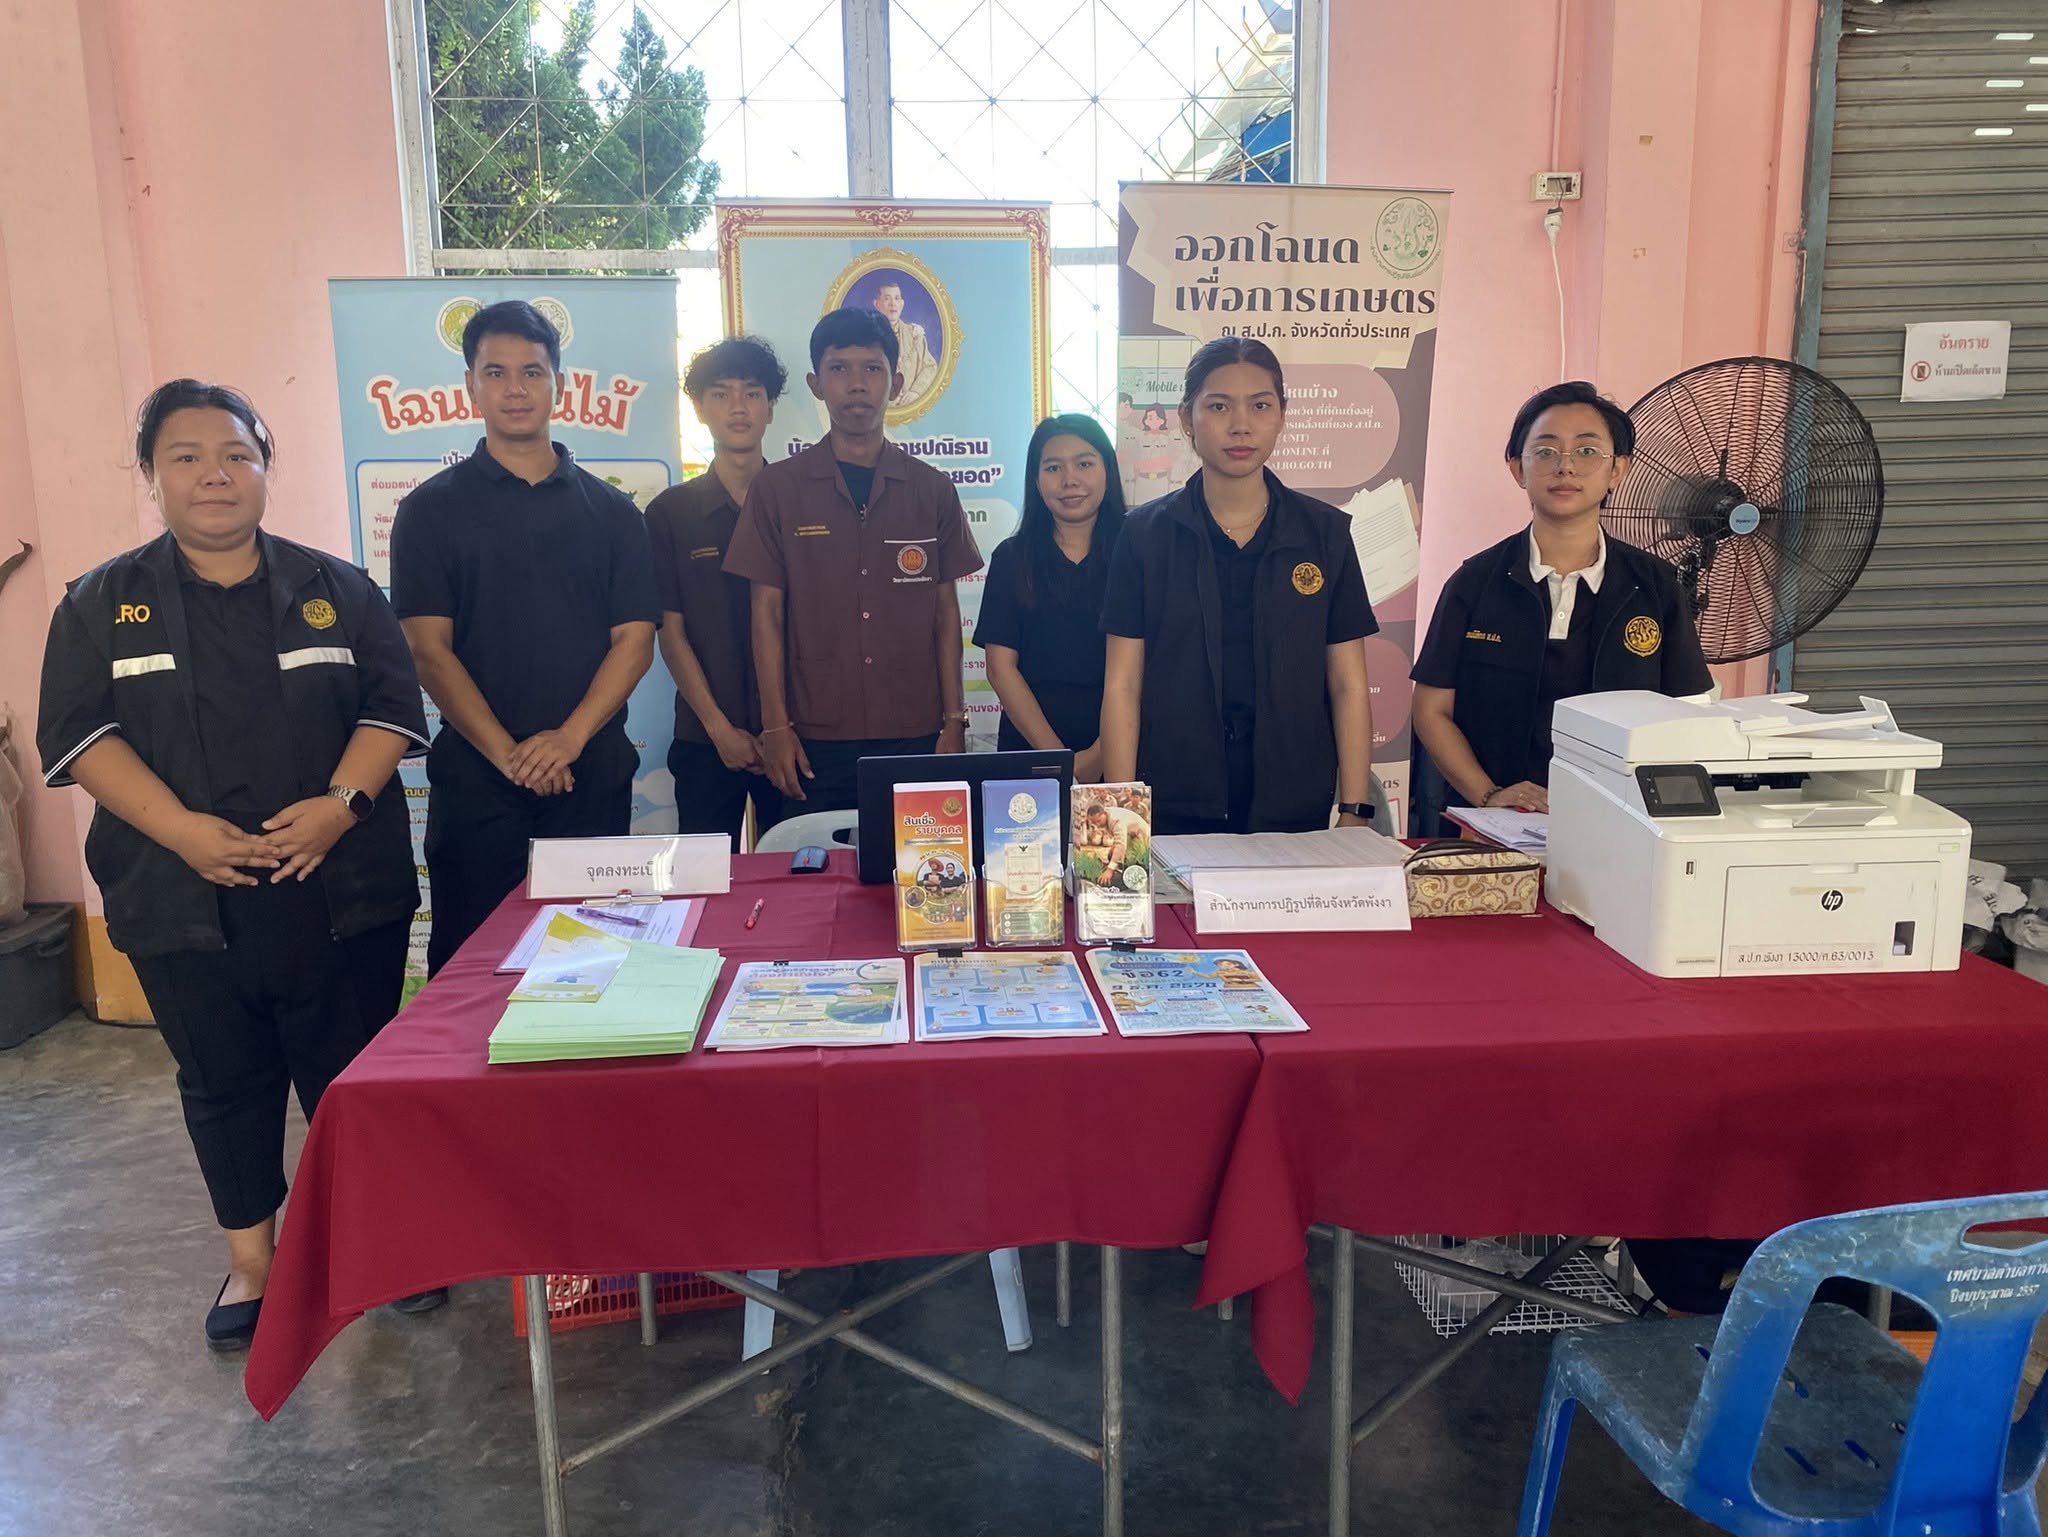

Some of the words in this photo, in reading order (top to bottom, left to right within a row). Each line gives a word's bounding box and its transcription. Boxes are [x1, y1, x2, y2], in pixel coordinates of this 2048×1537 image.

[1175, 222, 1360, 264] ออกโฉนด
[1175, 267, 1436, 314] เพื่อการเกษตร
[1291, 319, 1411, 339] จังหวัดทั่วประเทศ
[1939, 333, 1990, 350] อันตราย
[1146, 381, 1178, 393] Mobile
[1282, 447, 1319, 456] ONLINE
[904, 812, 935, 826] สินเชื่อ
[915, 825, 962, 837] รายบุคคล
[1210, 894, 1392, 913] สำนักงานการปฏิรูปที่ดินจังหวัดพังงา
[1822, 889, 1843, 911] hp
